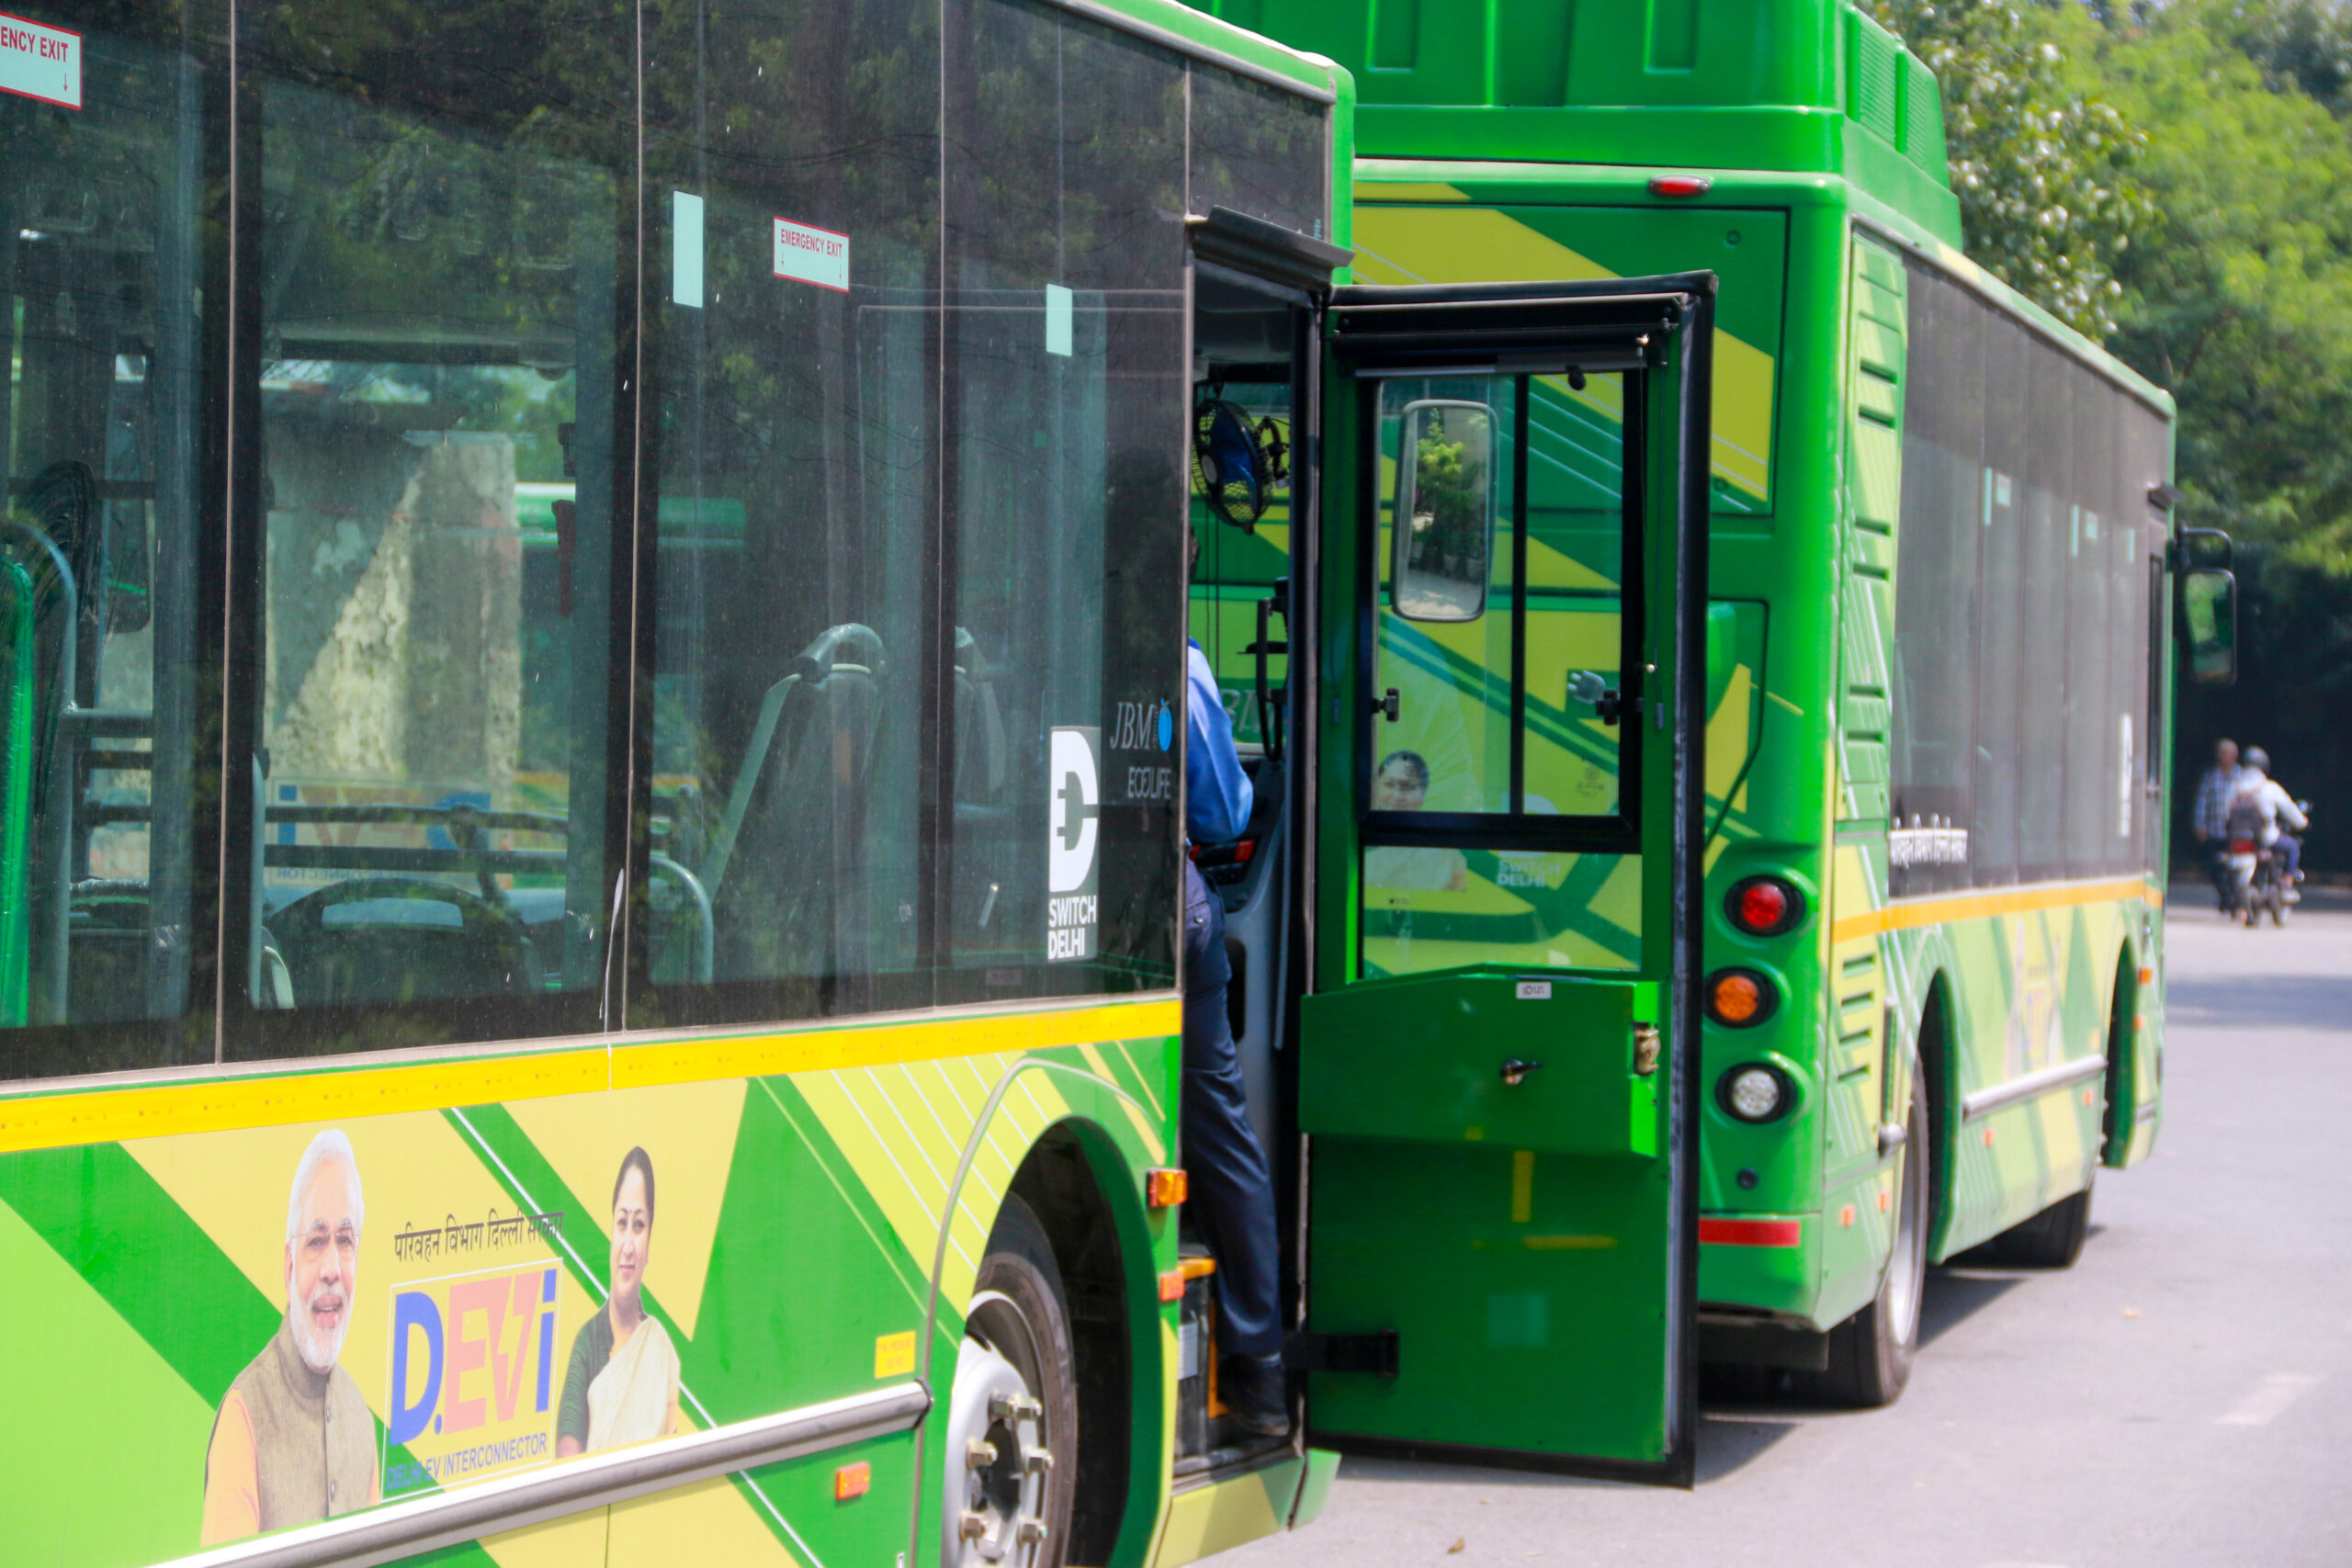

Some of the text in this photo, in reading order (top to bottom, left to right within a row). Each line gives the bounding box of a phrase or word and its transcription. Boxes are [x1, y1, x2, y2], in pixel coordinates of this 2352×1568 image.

[40, 36, 68, 62] EXIT
[781, 228, 842, 258] EMERGENCY EXIT
[1109, 701, 1157, 750] JBM
[1497, 873, 1545, 888] DELHI
[1498, 859, 1560, 875] SWITCH
[1048, 895, 1097, 928] SWITCH
[1047, 928, 1085, 960] DELHI
[394, 1207, 565, 1262] परिवहन विभाग दिल्ली सरकार
[386, 1432, 548, 1491] DELHI EV INTERCONNECTOR
